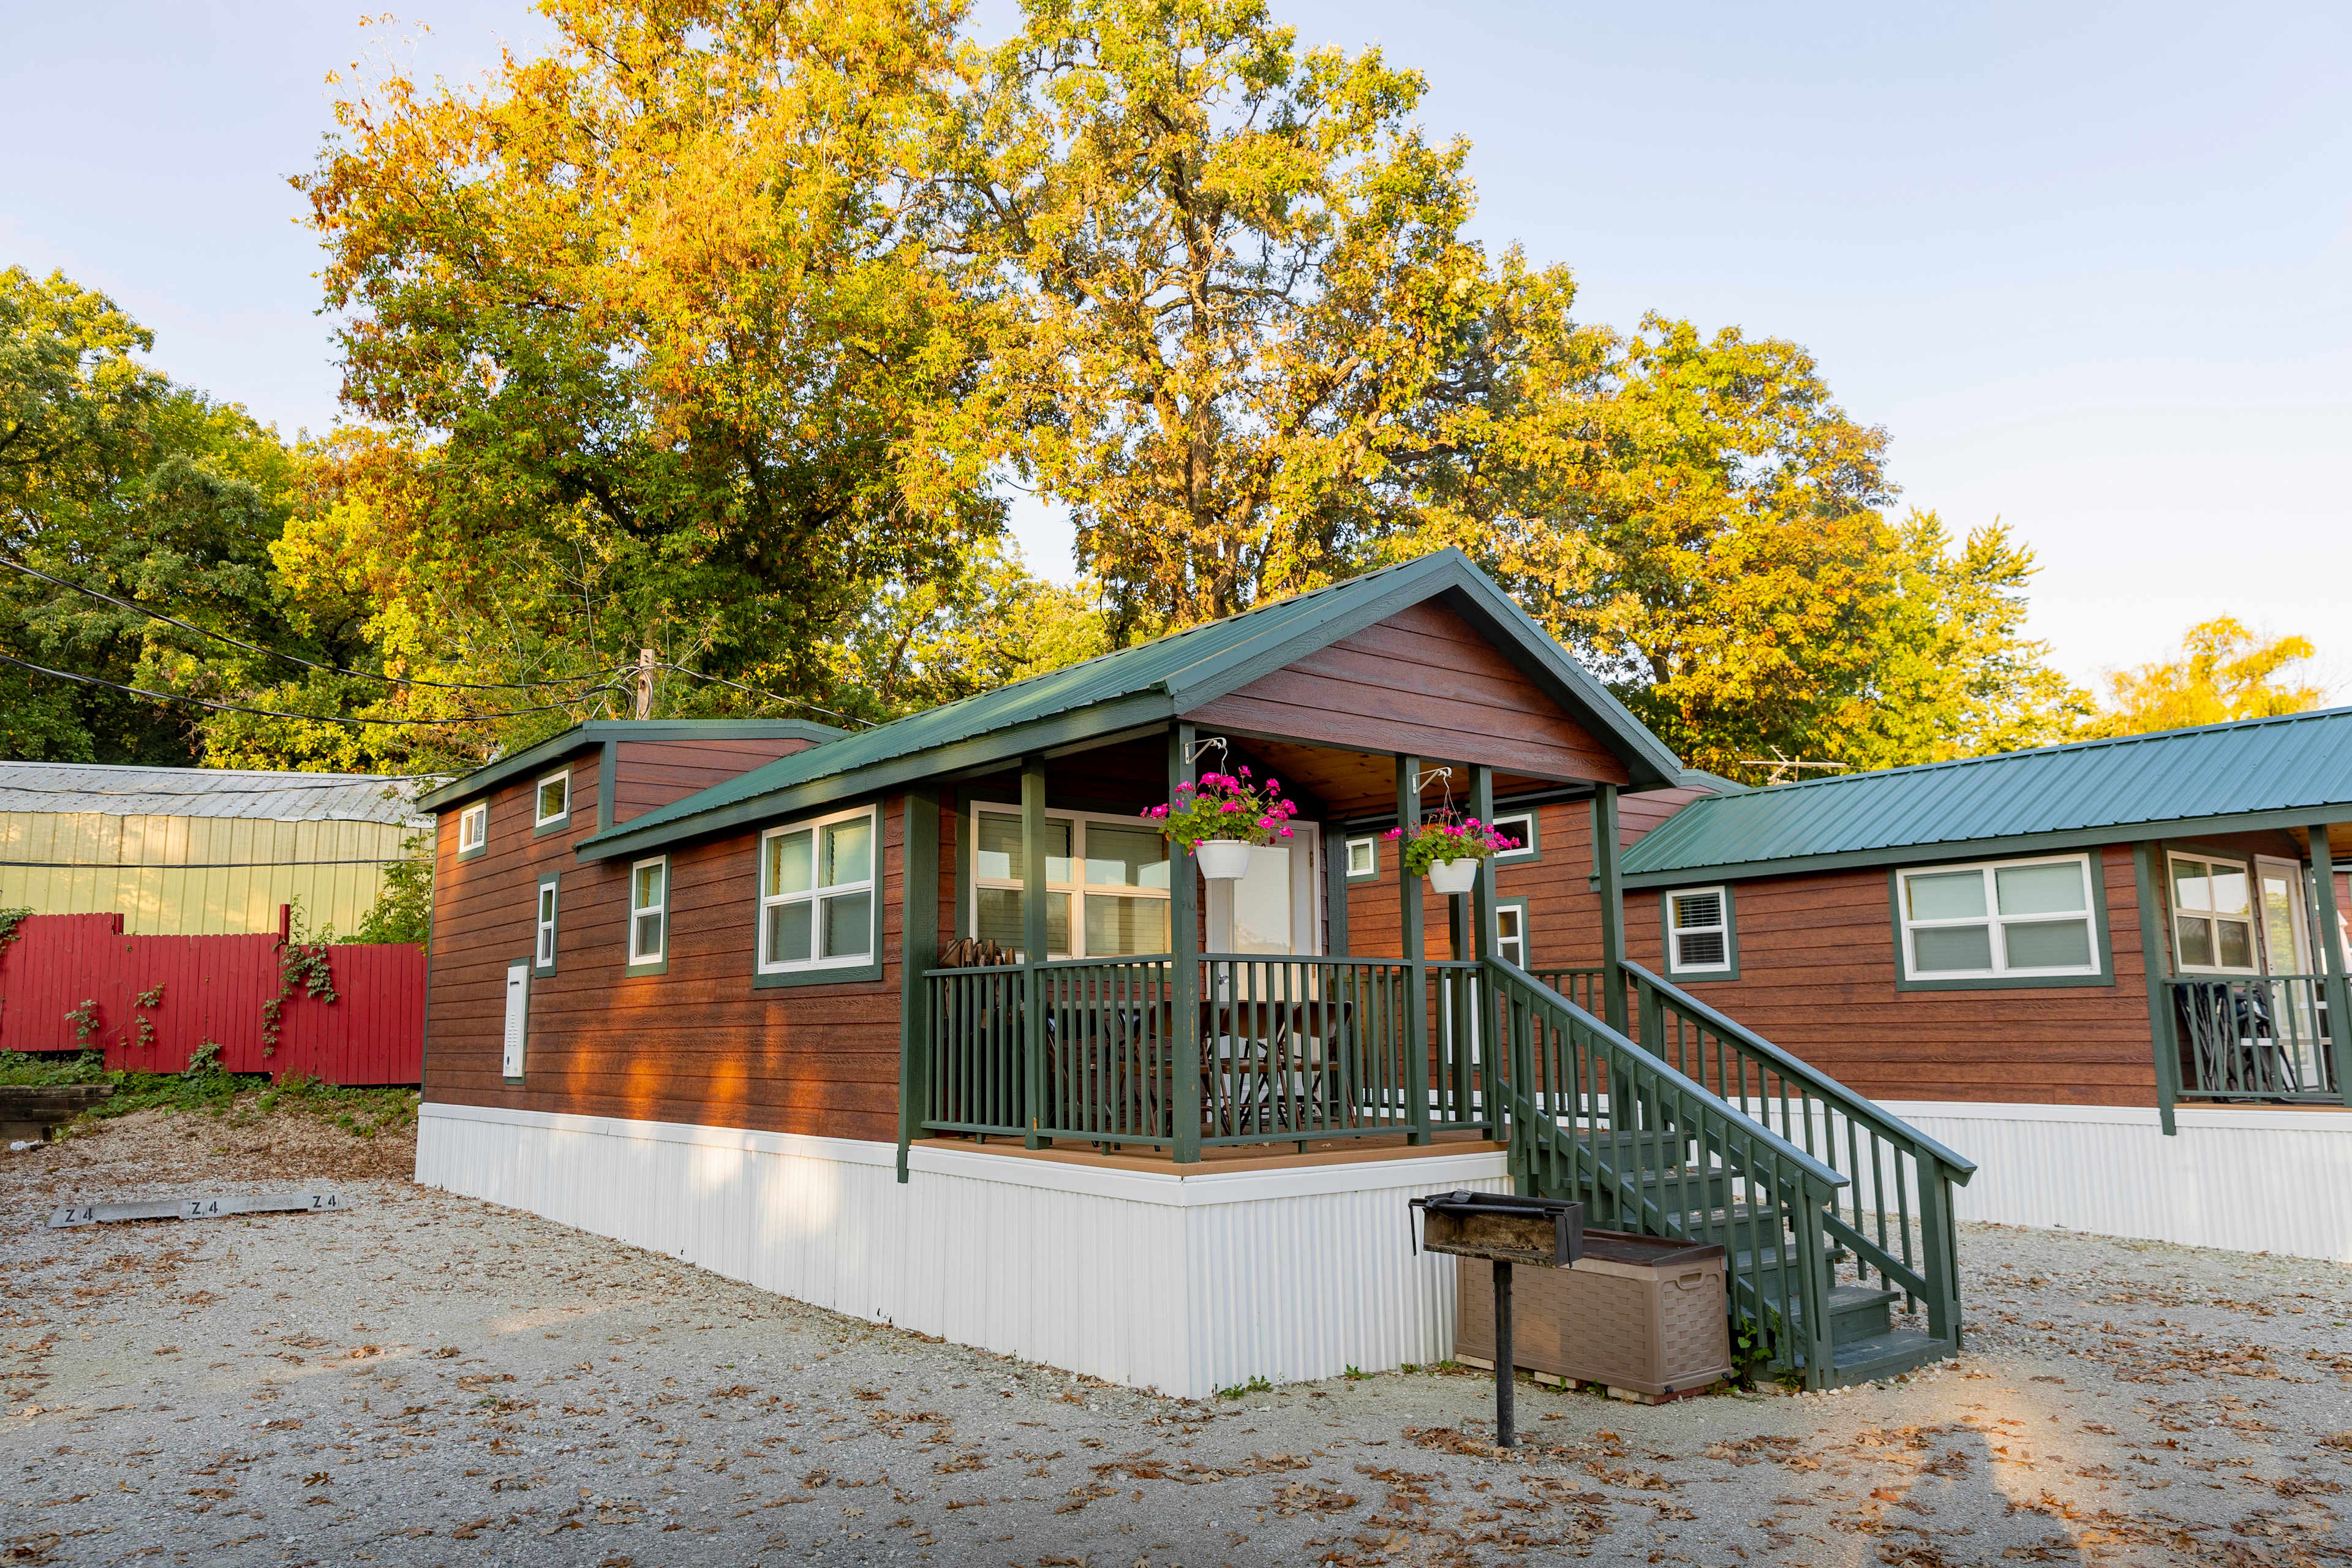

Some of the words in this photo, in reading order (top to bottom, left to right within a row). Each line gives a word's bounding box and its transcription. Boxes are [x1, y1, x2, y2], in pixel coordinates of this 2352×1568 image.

[192, 1202, 201, 1215] Z
[208, 1201, 218, 1213] 4
[313, 1196, 322, 1208] Z
[328, 1195, 336, 1207] 4
[65, 1209, 75, 1223] Z
[83, 1208, 93, 1221] 4
